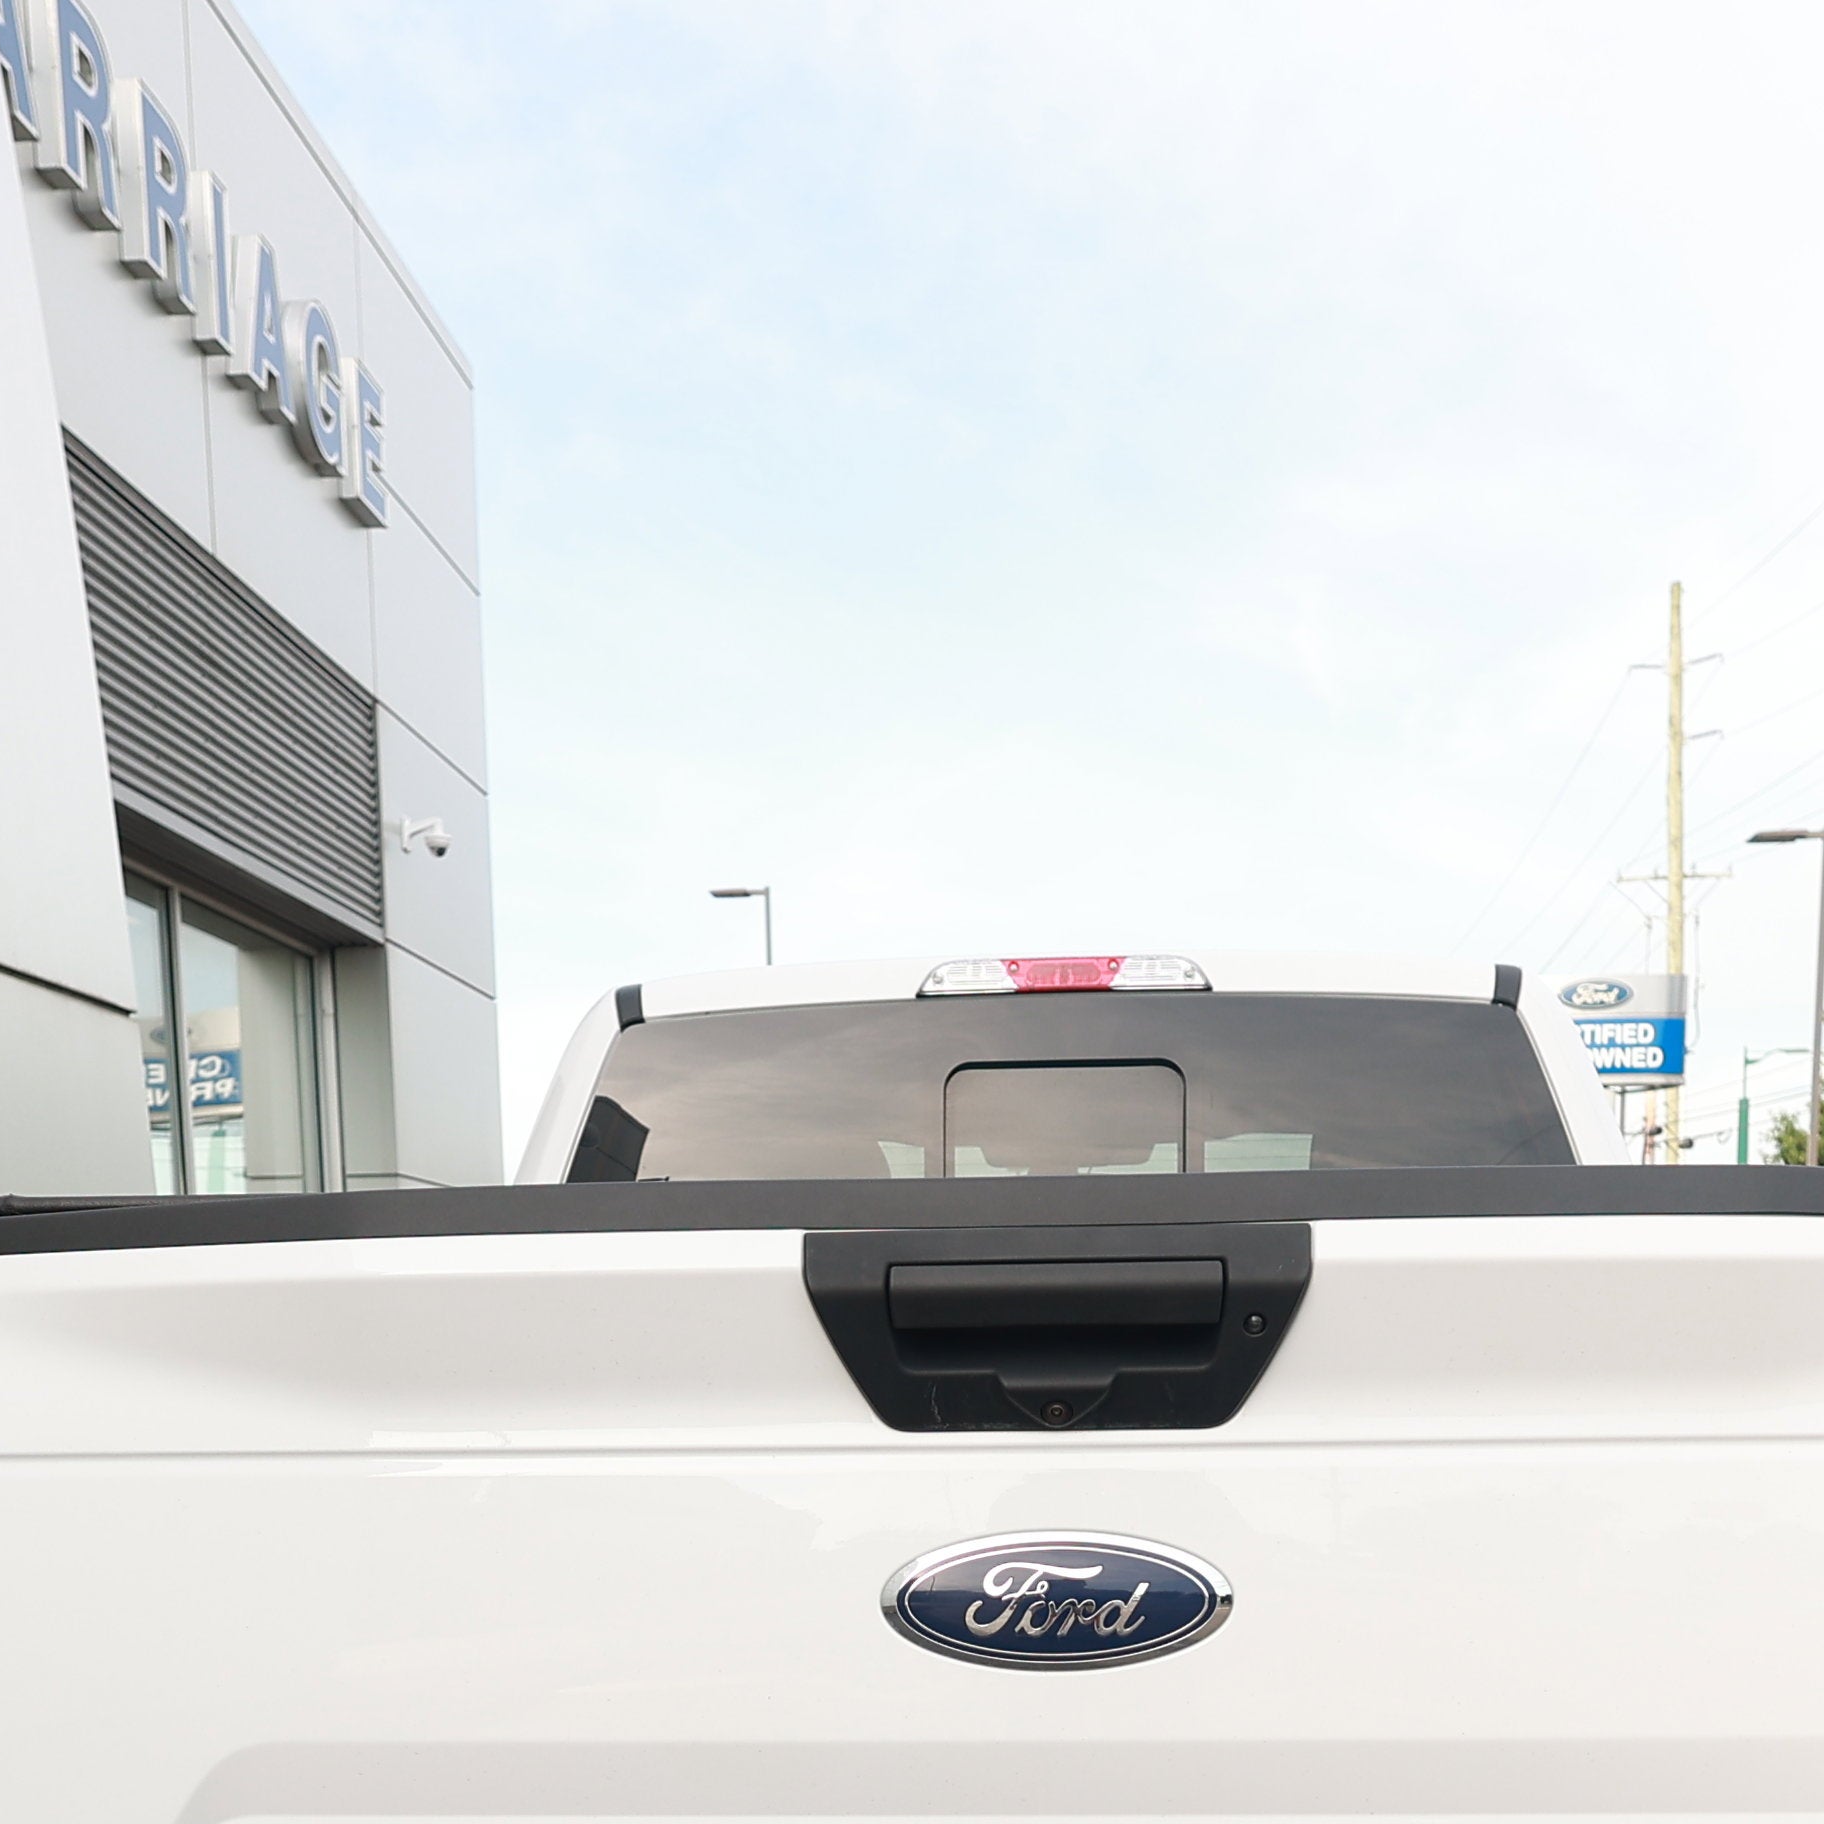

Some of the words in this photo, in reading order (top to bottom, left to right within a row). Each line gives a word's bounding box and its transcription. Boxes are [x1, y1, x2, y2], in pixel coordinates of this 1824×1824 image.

[1572, 983, 1621, 1005] Ford
[1587, 1046, 1664, 1069] WNED
[964, 1561, 1151, 1638] Ford
